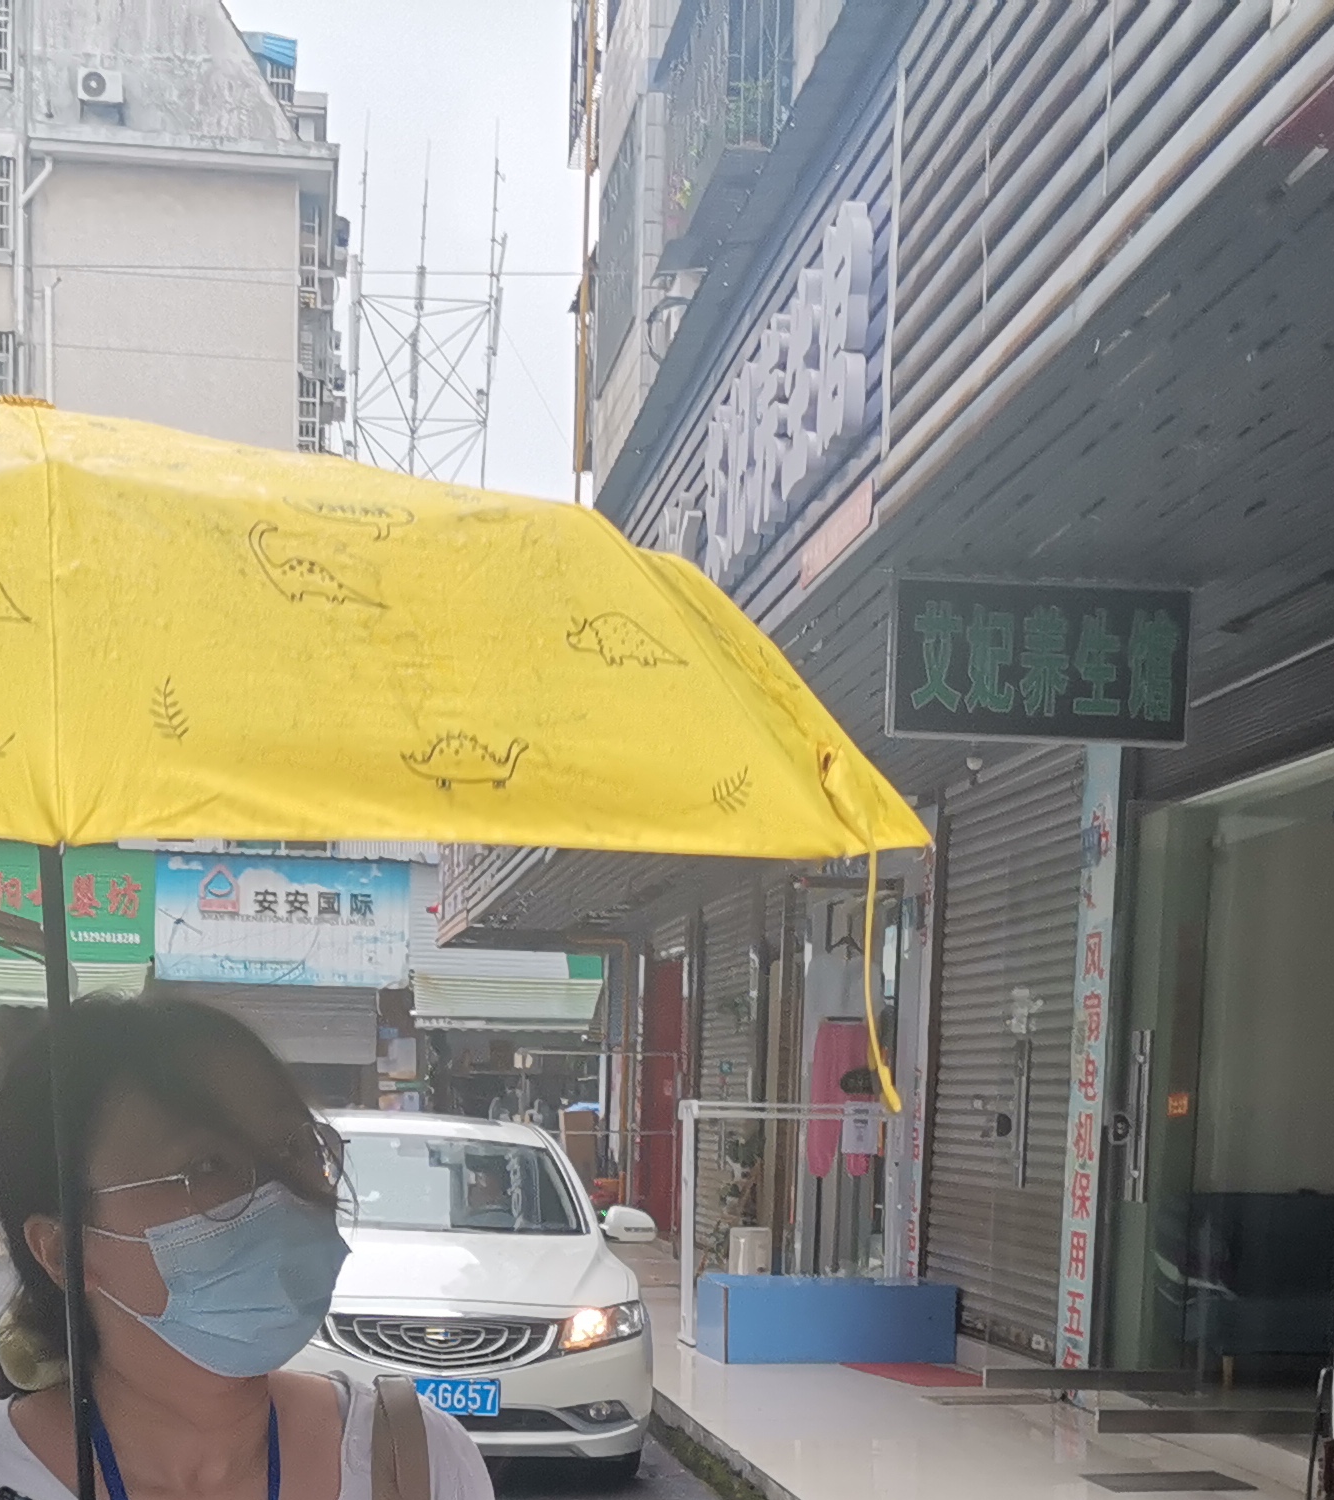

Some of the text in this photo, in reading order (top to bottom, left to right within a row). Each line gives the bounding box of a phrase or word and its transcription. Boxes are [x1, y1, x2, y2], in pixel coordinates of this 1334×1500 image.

[910, 600, 1182, 722] 艾妃养生馆
[253, 889, 375, 917] 安安国际
[414, 1382, 497, 1411] 6G657
